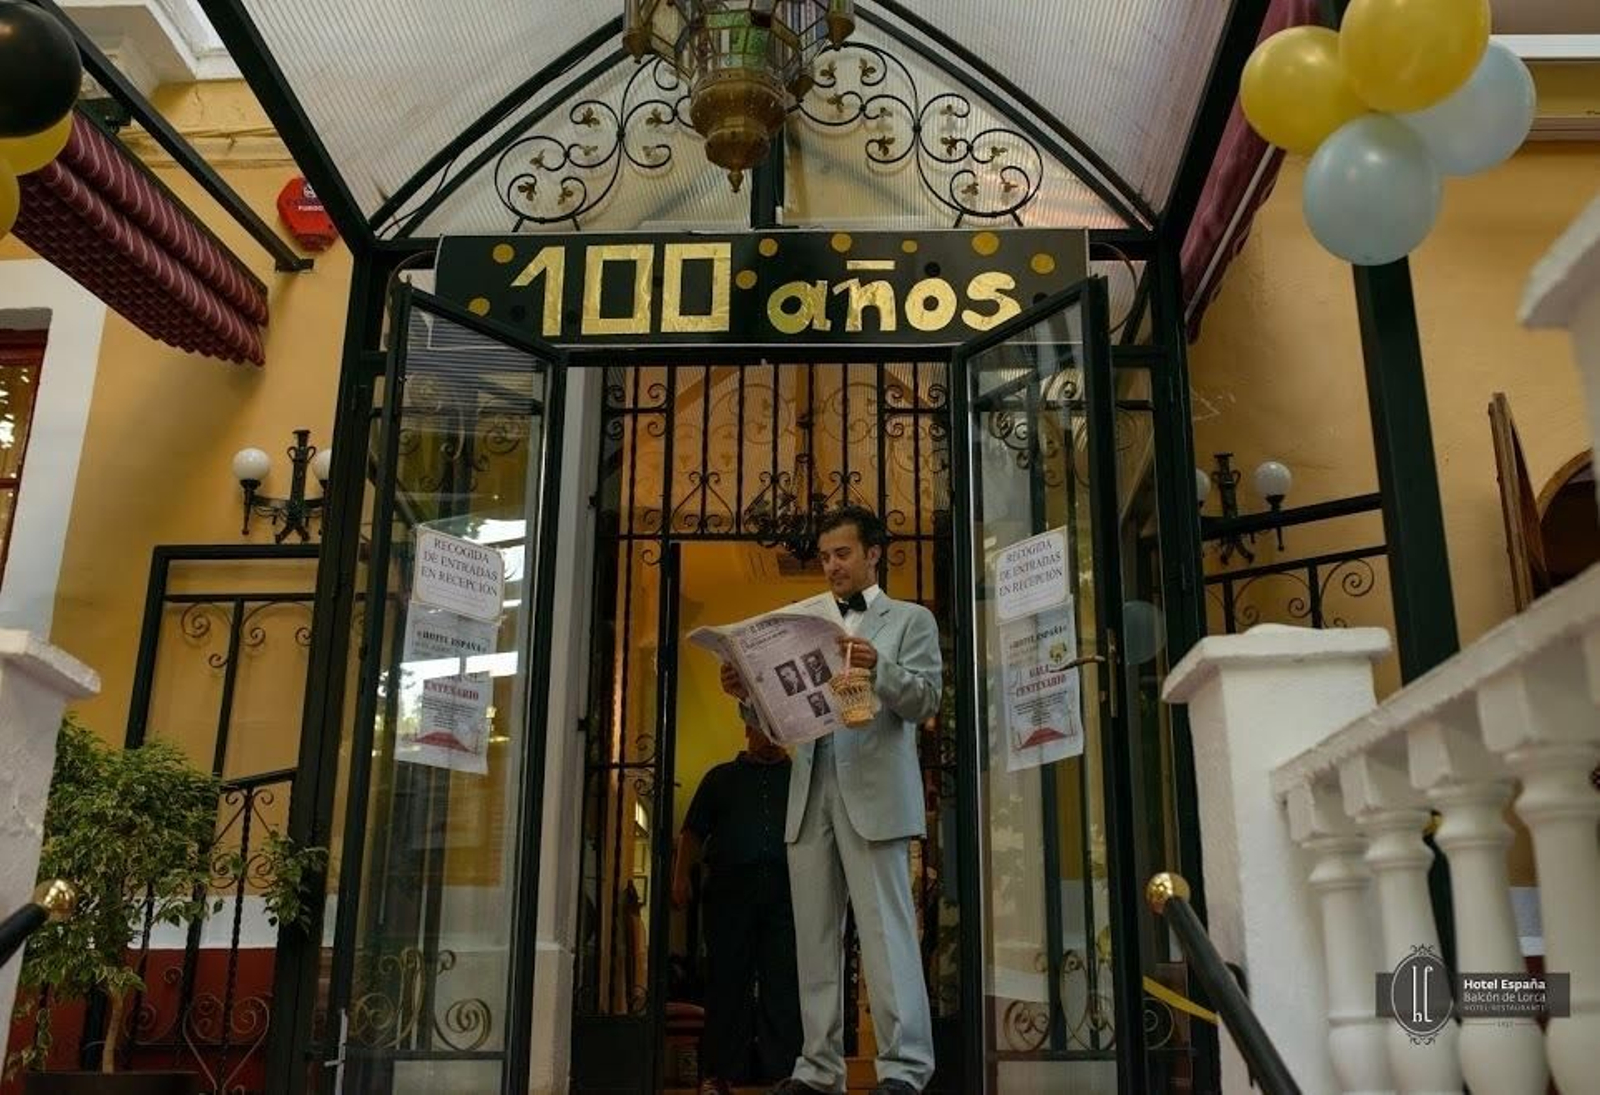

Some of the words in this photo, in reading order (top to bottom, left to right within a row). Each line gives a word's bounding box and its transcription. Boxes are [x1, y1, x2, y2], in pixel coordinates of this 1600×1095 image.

[510, 242, 732, 337] 100
[766, 259, 1022, 334] años
[433, 537, 490, 564] RECOGIDA
[1006, 539, 1053, 563] RECOGIDA
[421, 565, 436, 579] EN
[423, 550, 439, 564] DE
[440, 555, 498, 582] ENTRADAS
[1000, 569, 1012, 581] DE
[1012, 551, 1062, 577] ENTRADAS
[999, 585, 1011, 597] EN
[1016, 674, 1066, 698] CENTENARIO
